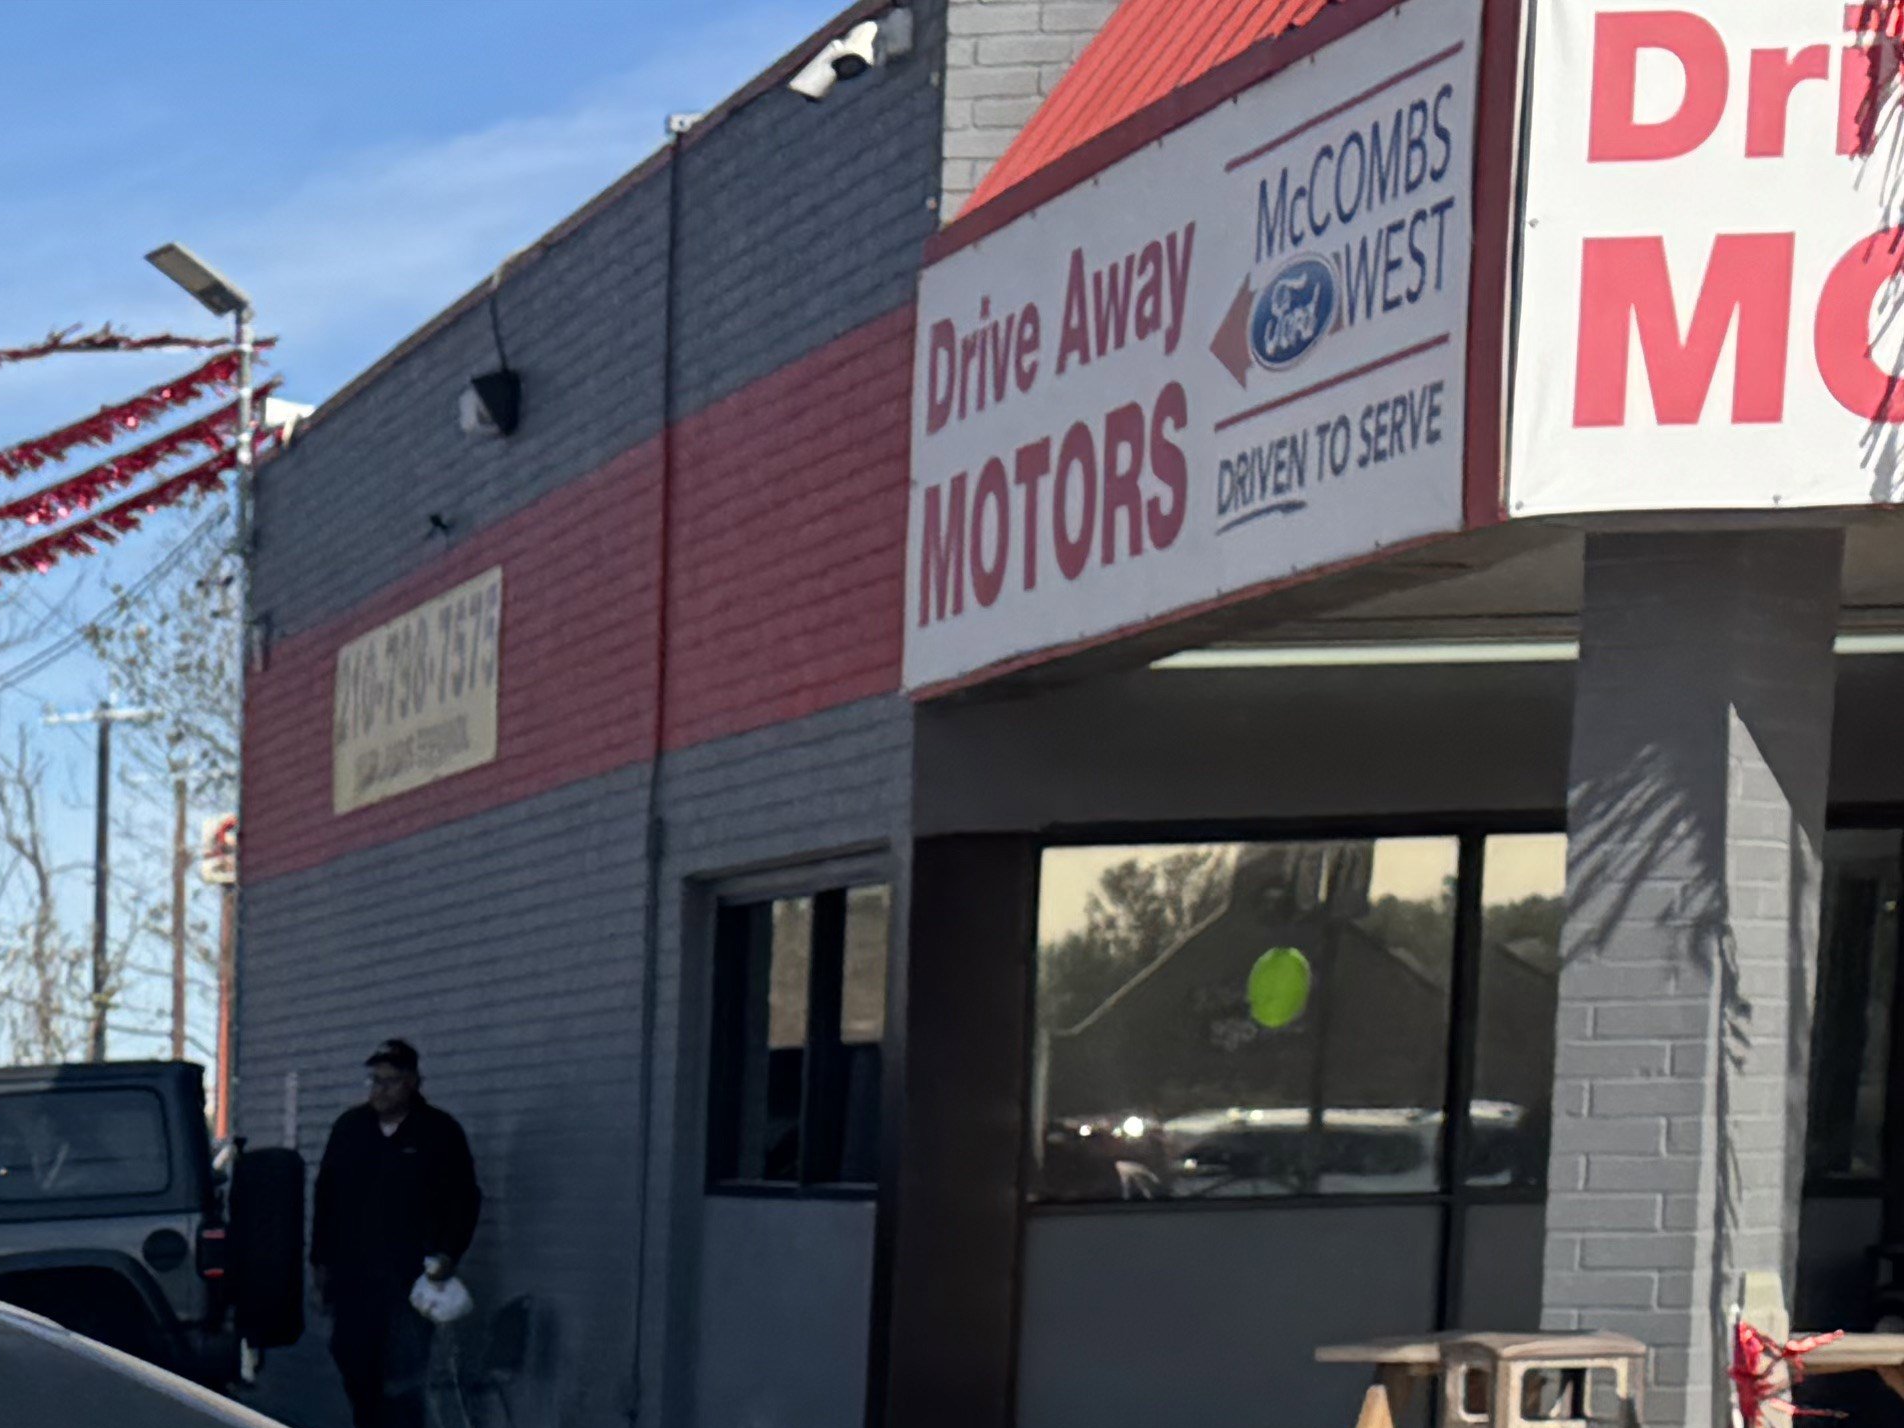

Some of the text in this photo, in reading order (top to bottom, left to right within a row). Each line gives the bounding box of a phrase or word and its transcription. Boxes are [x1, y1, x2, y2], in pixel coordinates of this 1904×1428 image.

[1255, 83, 1452, 263] McCOMBS
[927, 220, 1196, 436] Drive Away
[1261, 268, 1325, 358] Ford
[1344, 196, 1455, 327] WEST
[918, 380, 1189, 628] MOTORS
[1216, 379, 1445, 517] DRIVEN TO SERVE
